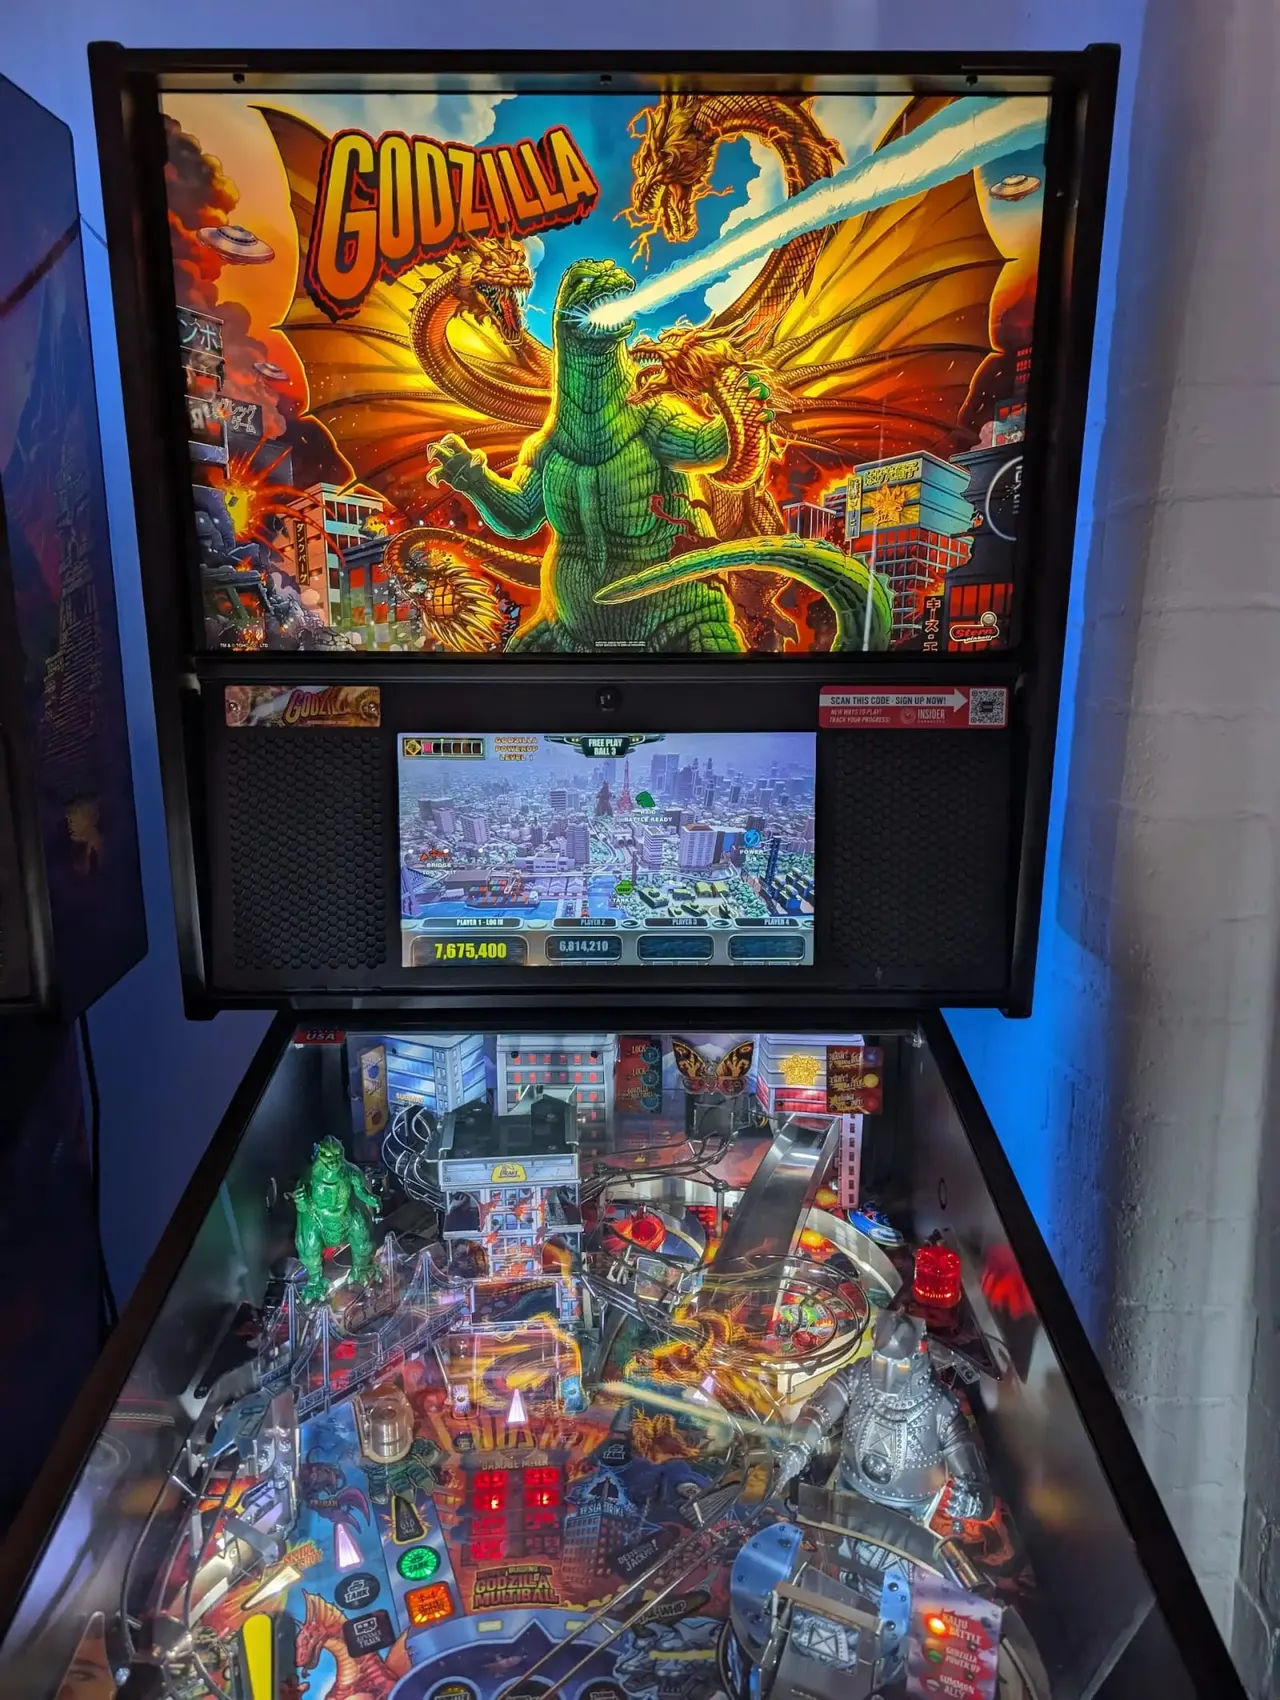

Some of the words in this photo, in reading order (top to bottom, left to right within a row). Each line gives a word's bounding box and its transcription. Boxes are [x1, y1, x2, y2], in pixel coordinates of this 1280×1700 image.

[312, 127, 600, 304] GODZILLA
[955, 629, 993, 637] Stern
[830, 696, 850, 704] SCAN
[853, 696, 869, 704] THIS
[870, 696, 890, 704] CODE
[895, 696, 913, 704] SIGN
[914, 696, 924, 704] UP
[926, 696, 946, 704] NOW!
[917, 709, 945, 720] INSIDER
[588, 738, 605, 747] FREE
[606, 738, 623, 747] PLAY
[594, 747, 610, 756] BALL
[610, 747, 617, 756] 3
[486, 918, 498, 926] LOG
[434, 943, 507, 960] 7,675,400
[559, 940, 608, 953] 6,814,210
[475, 1573, 550, 1594] GODZILLA
[473, 1588, 560, 1609] MULTIBALL
[942, 1613, 968, 1630] KAIJU
[949, 1627, 982, 1645] BATTLE
[939, 1674, 975, 1694] SUMMON
[944, 1685, 966, 1699] ALLY
